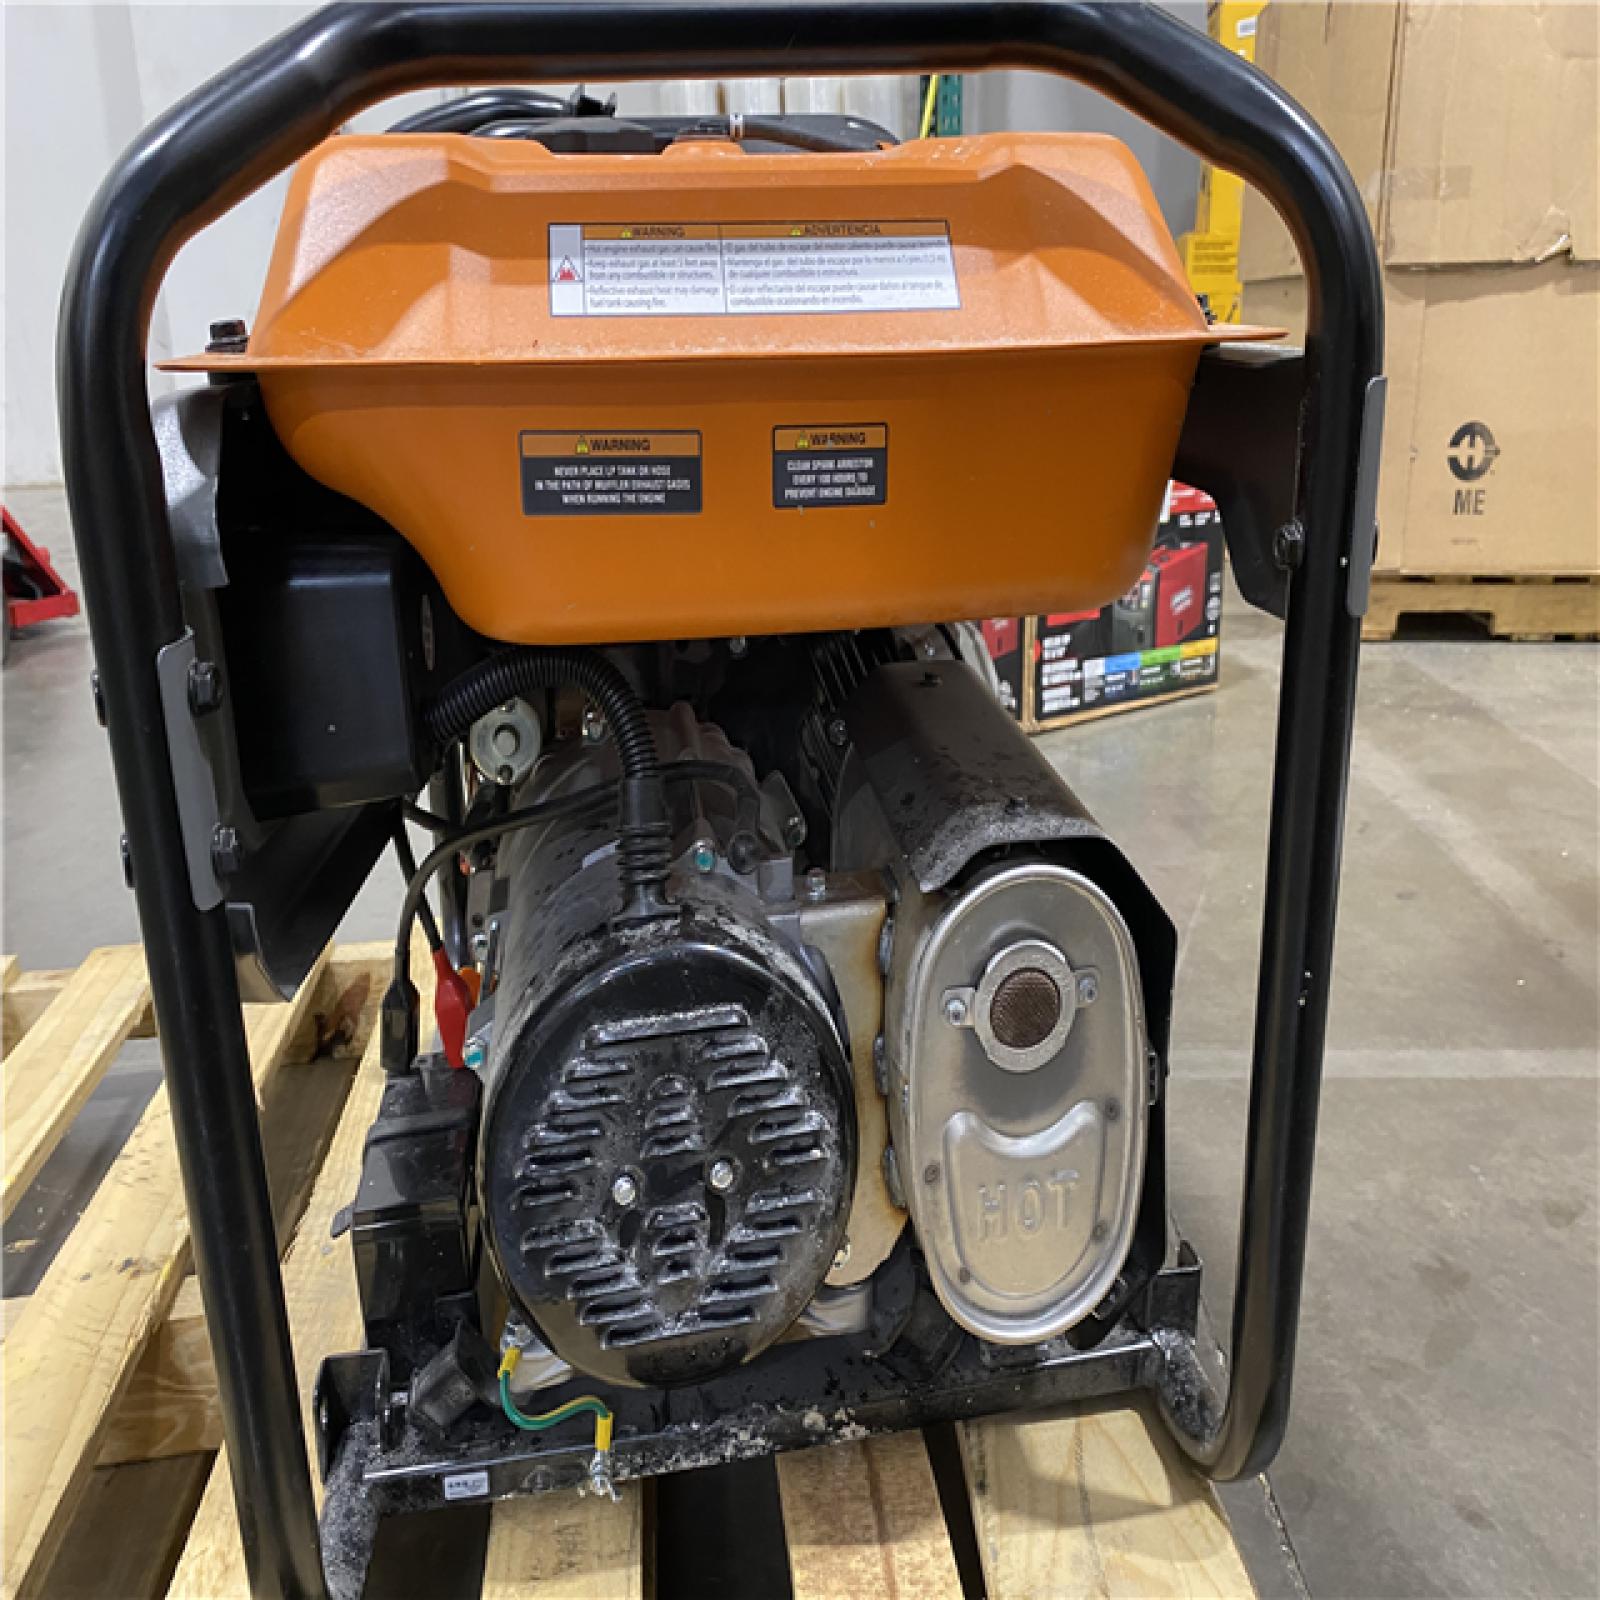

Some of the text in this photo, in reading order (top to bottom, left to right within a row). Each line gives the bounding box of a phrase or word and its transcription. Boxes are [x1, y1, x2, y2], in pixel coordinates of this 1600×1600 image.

[631, 226, 685, 239] WARNING
[804, 224, 880, 236] ADVERTENCIA
[589, 439, 651, 451] WARNING
[810, 432, 865, 445] WARNING
[1453, 489, 1486, 515] ME
[977, 1169, 1080, 1241] HOT
